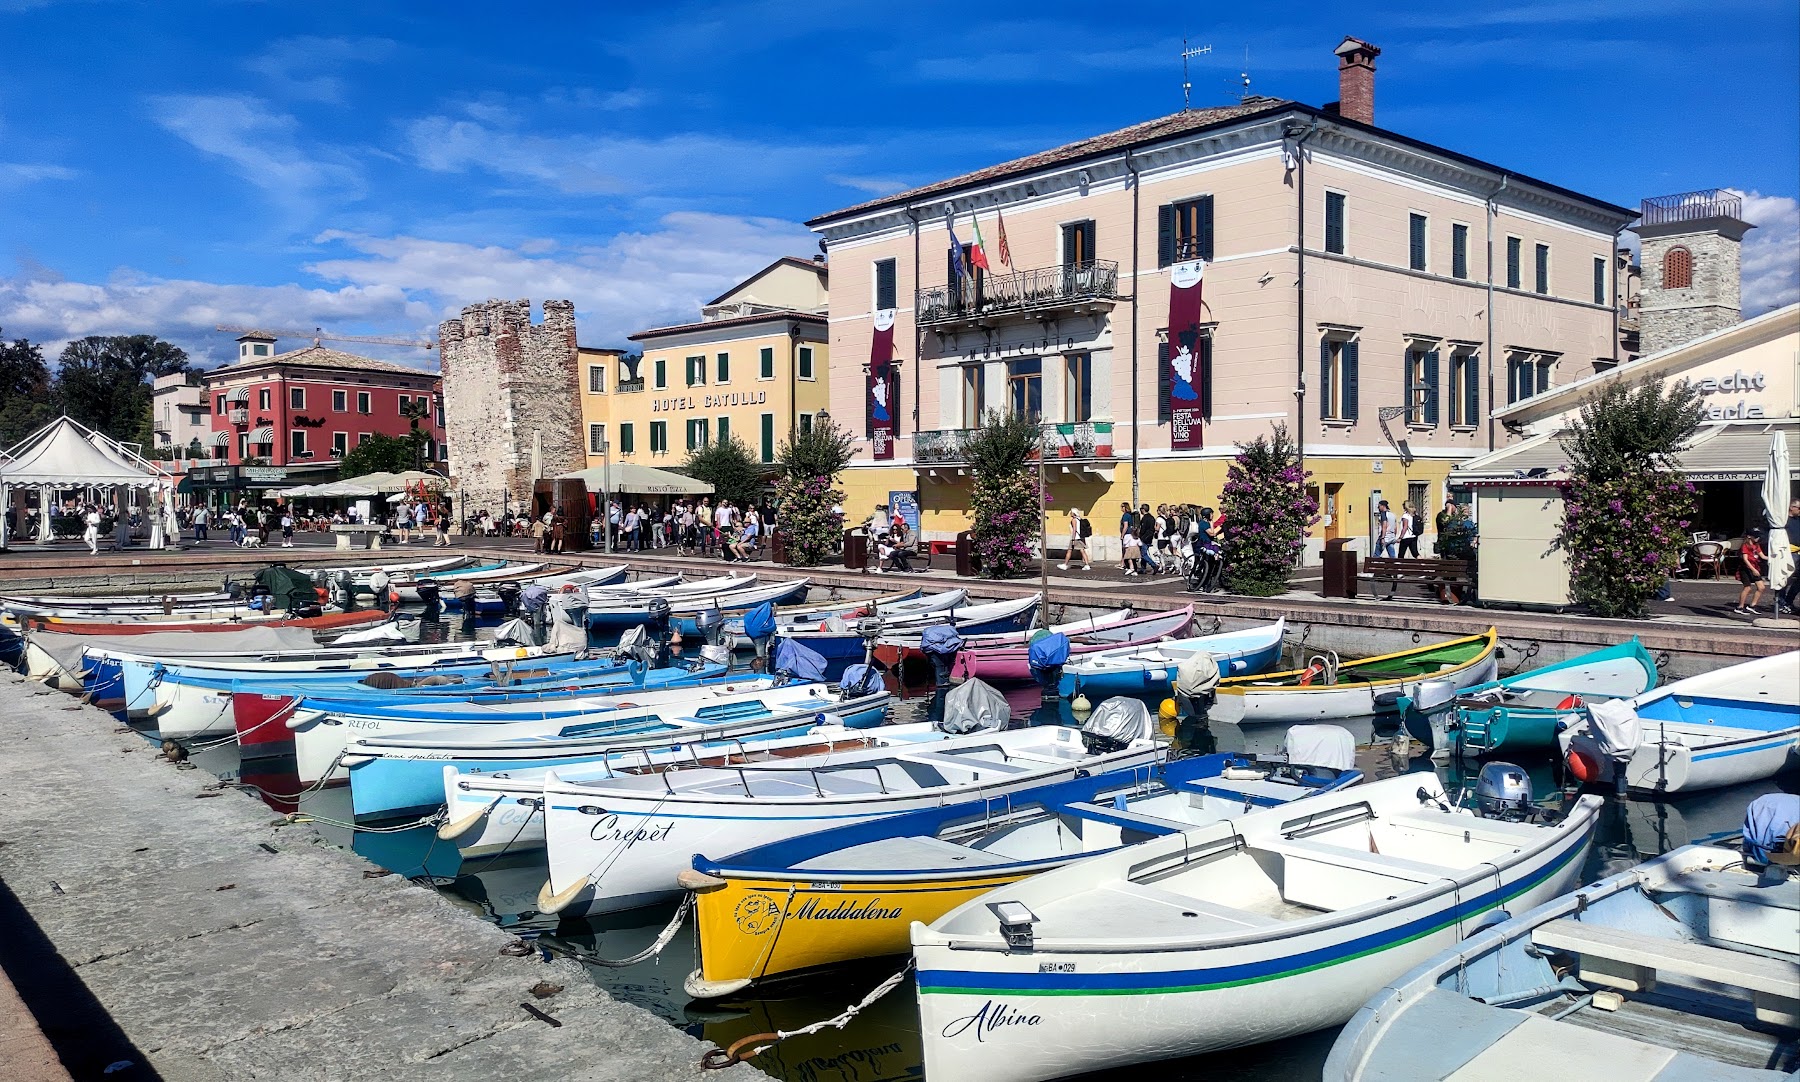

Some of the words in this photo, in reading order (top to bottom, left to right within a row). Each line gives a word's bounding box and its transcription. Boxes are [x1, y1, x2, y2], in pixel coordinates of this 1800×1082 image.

[970, 337, 1074, 360] MUNICIPIO
[653, 396, 695, 412] HOTEL
[704, 391, 766, 408] CATULLO
[1699, 399, 1764, 420] eria
[1173, 412, 1192, 420] FESTA
[1173, 418, 1202, 426] DELL'UVA
[1173, 431, 1190, 439] VINO
[348, 719, 381, 730] REFOL
[590, 813, 676, 849] Crepèt
[786, 897, 903, 920] Maddalena
[942, 999, 1046, 1043] Albina
